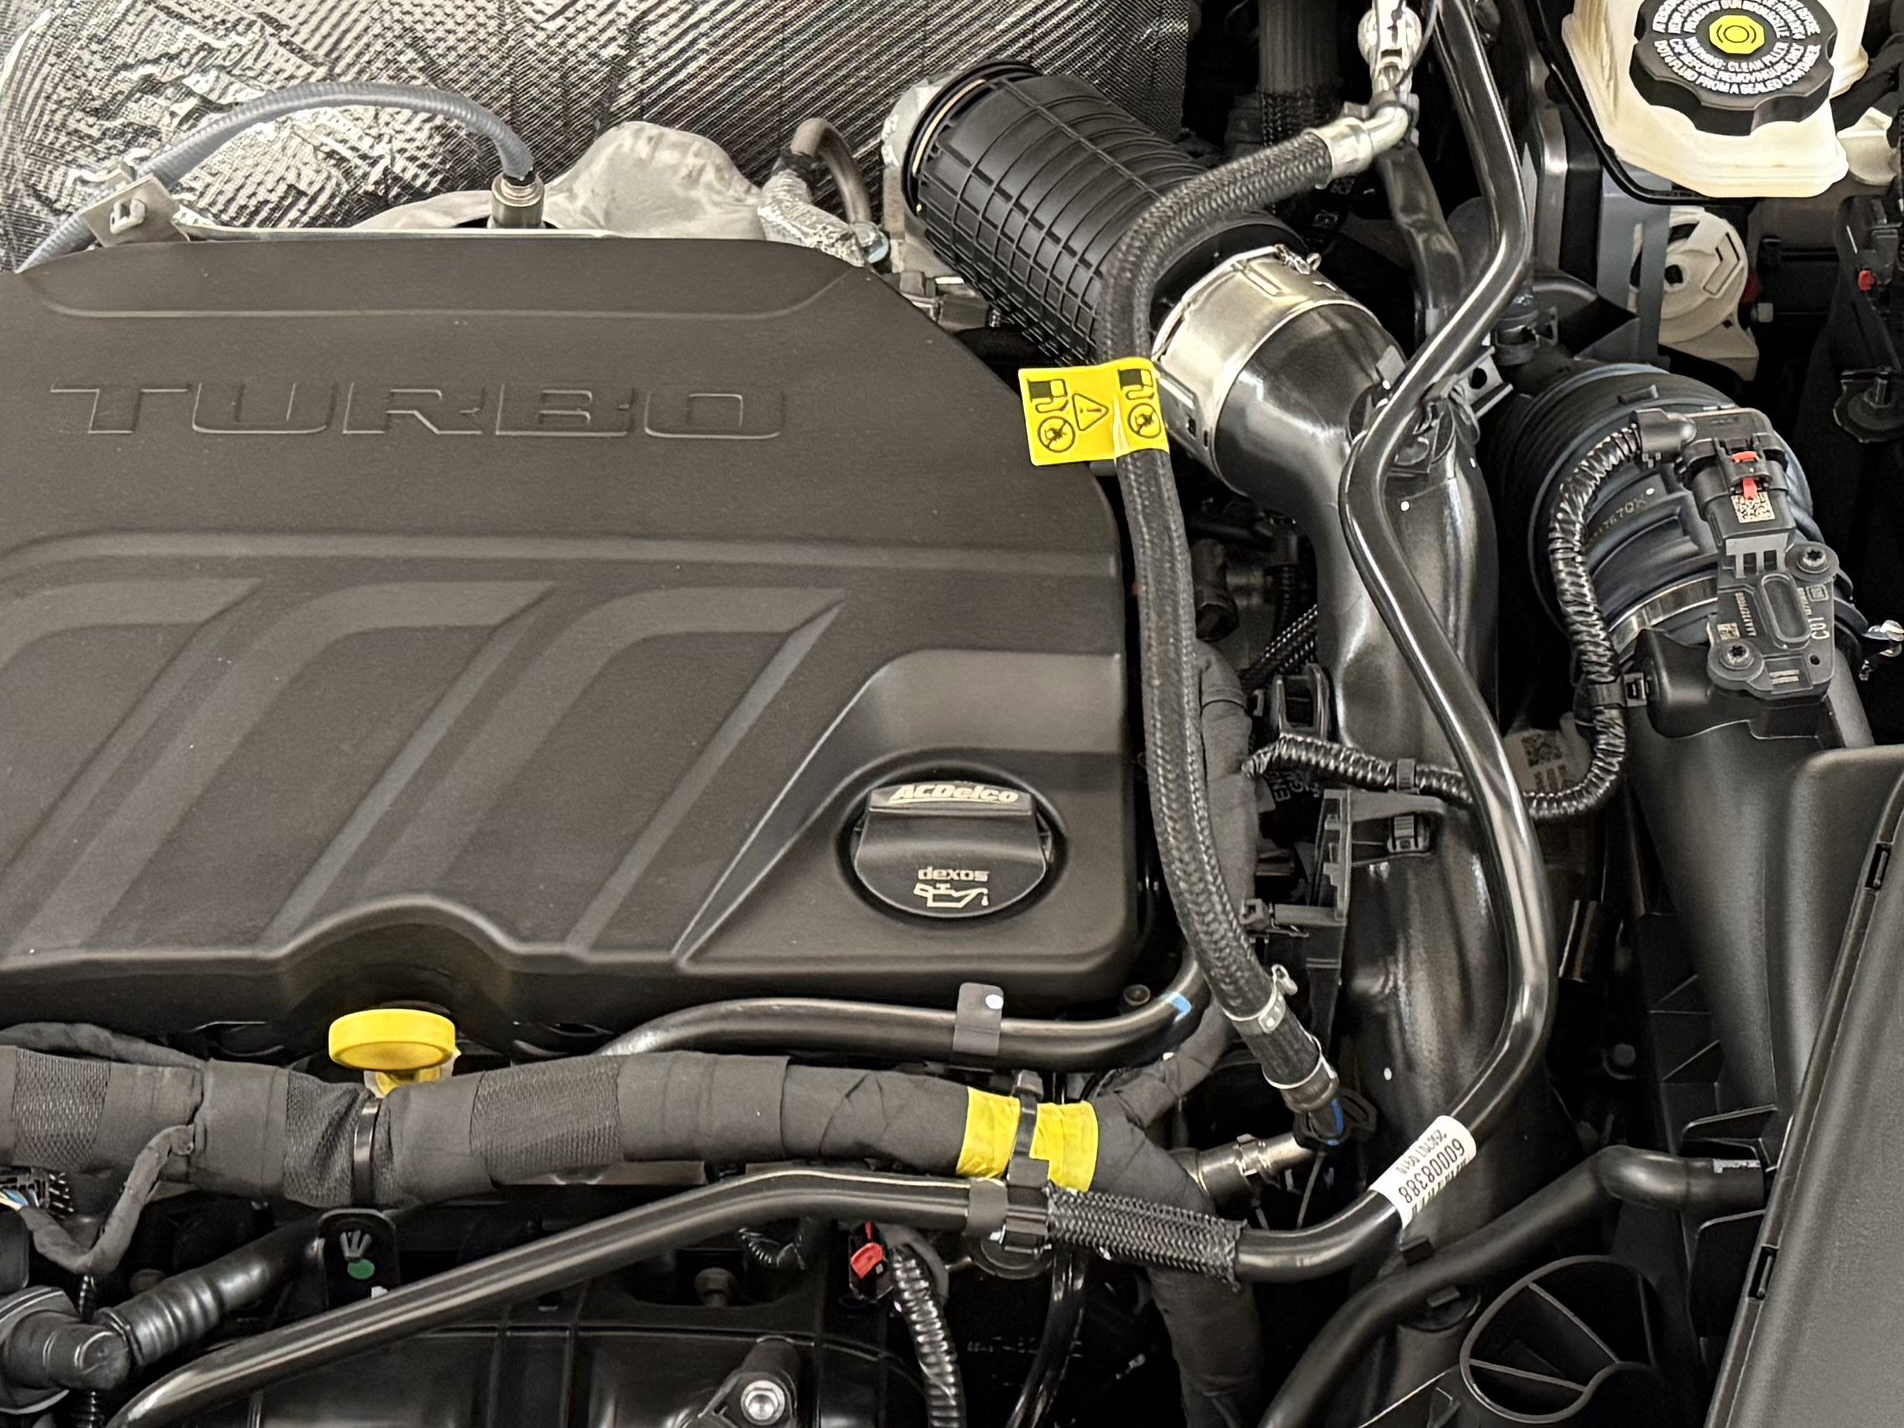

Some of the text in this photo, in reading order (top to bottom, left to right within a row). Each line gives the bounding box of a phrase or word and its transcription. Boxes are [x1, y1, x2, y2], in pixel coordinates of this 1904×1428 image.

[1726, 59, 1766, 72] CLEAN
[1693, 75, 1729, 92] FROM
[1729, 83, 1738, 93] A
[1740, 77, 1785, 93] SEALED
[50, 381, 786, 439] TURBO
[890, 783, 1019, 803] ACDelco
[917, 866, 990, 882] dexos
[1398, 1137, 1465, 1203] 60008388
